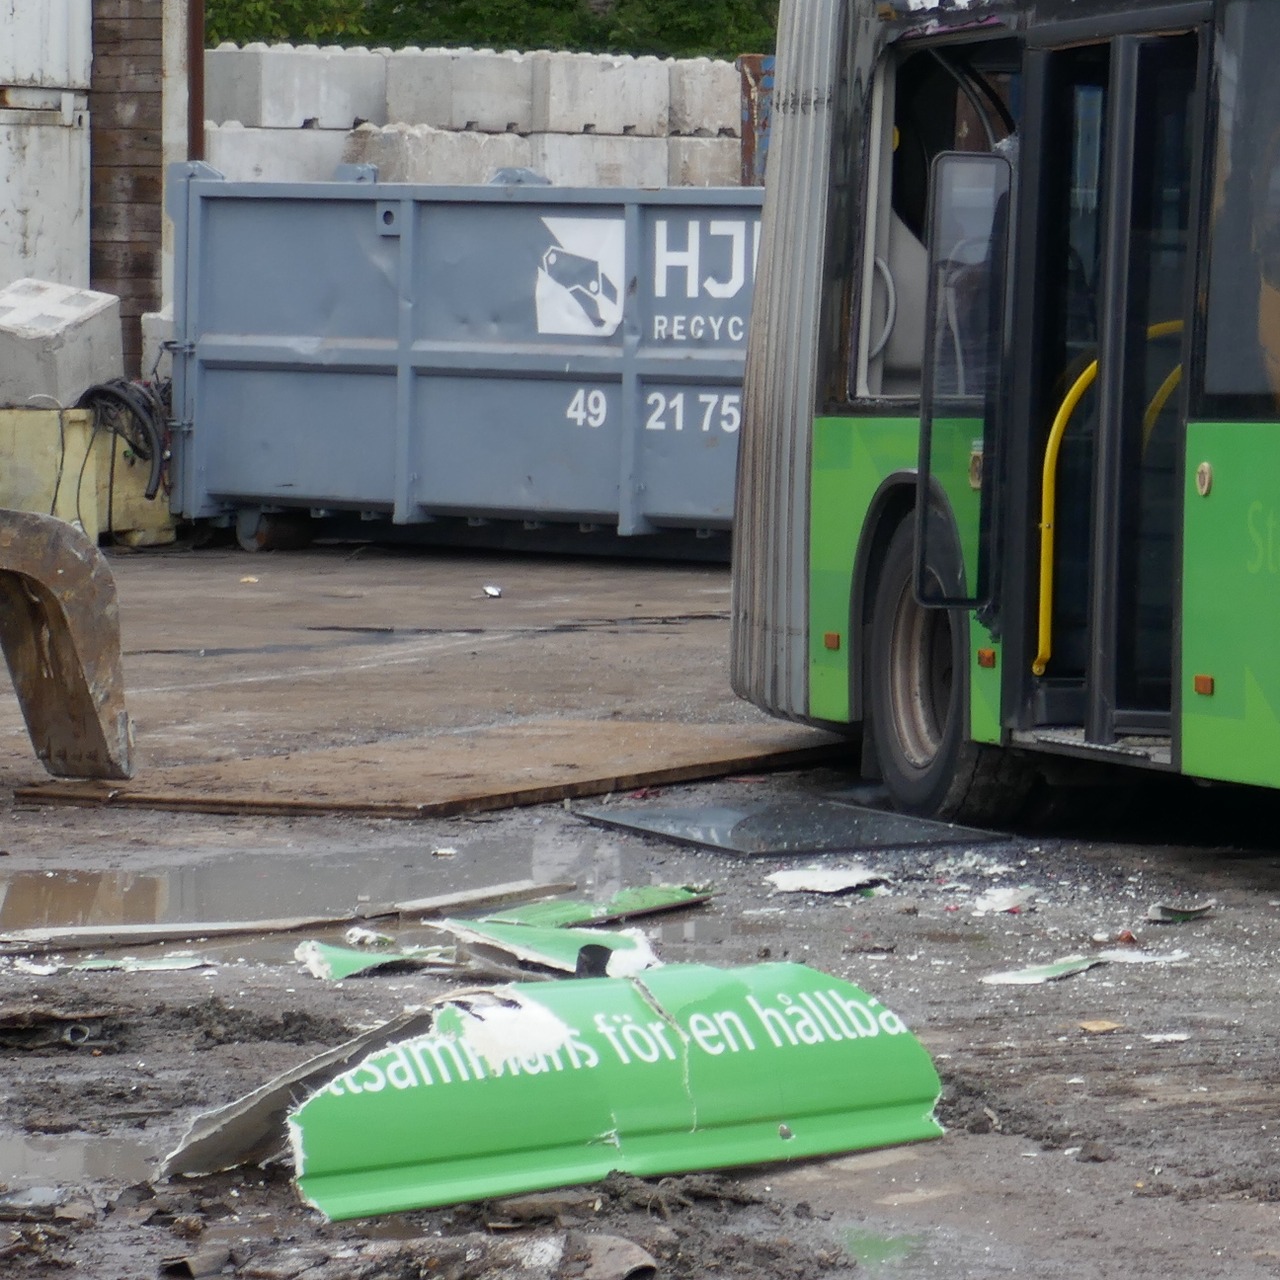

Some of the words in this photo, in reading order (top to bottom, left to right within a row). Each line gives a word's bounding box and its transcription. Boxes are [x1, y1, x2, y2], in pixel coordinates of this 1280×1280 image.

[654, 220, 762, 298] HJ
[566, 389, 607, 428] 49
[593, 1013, 677, 1065] för
[688, 1010, 756, 1056] en
